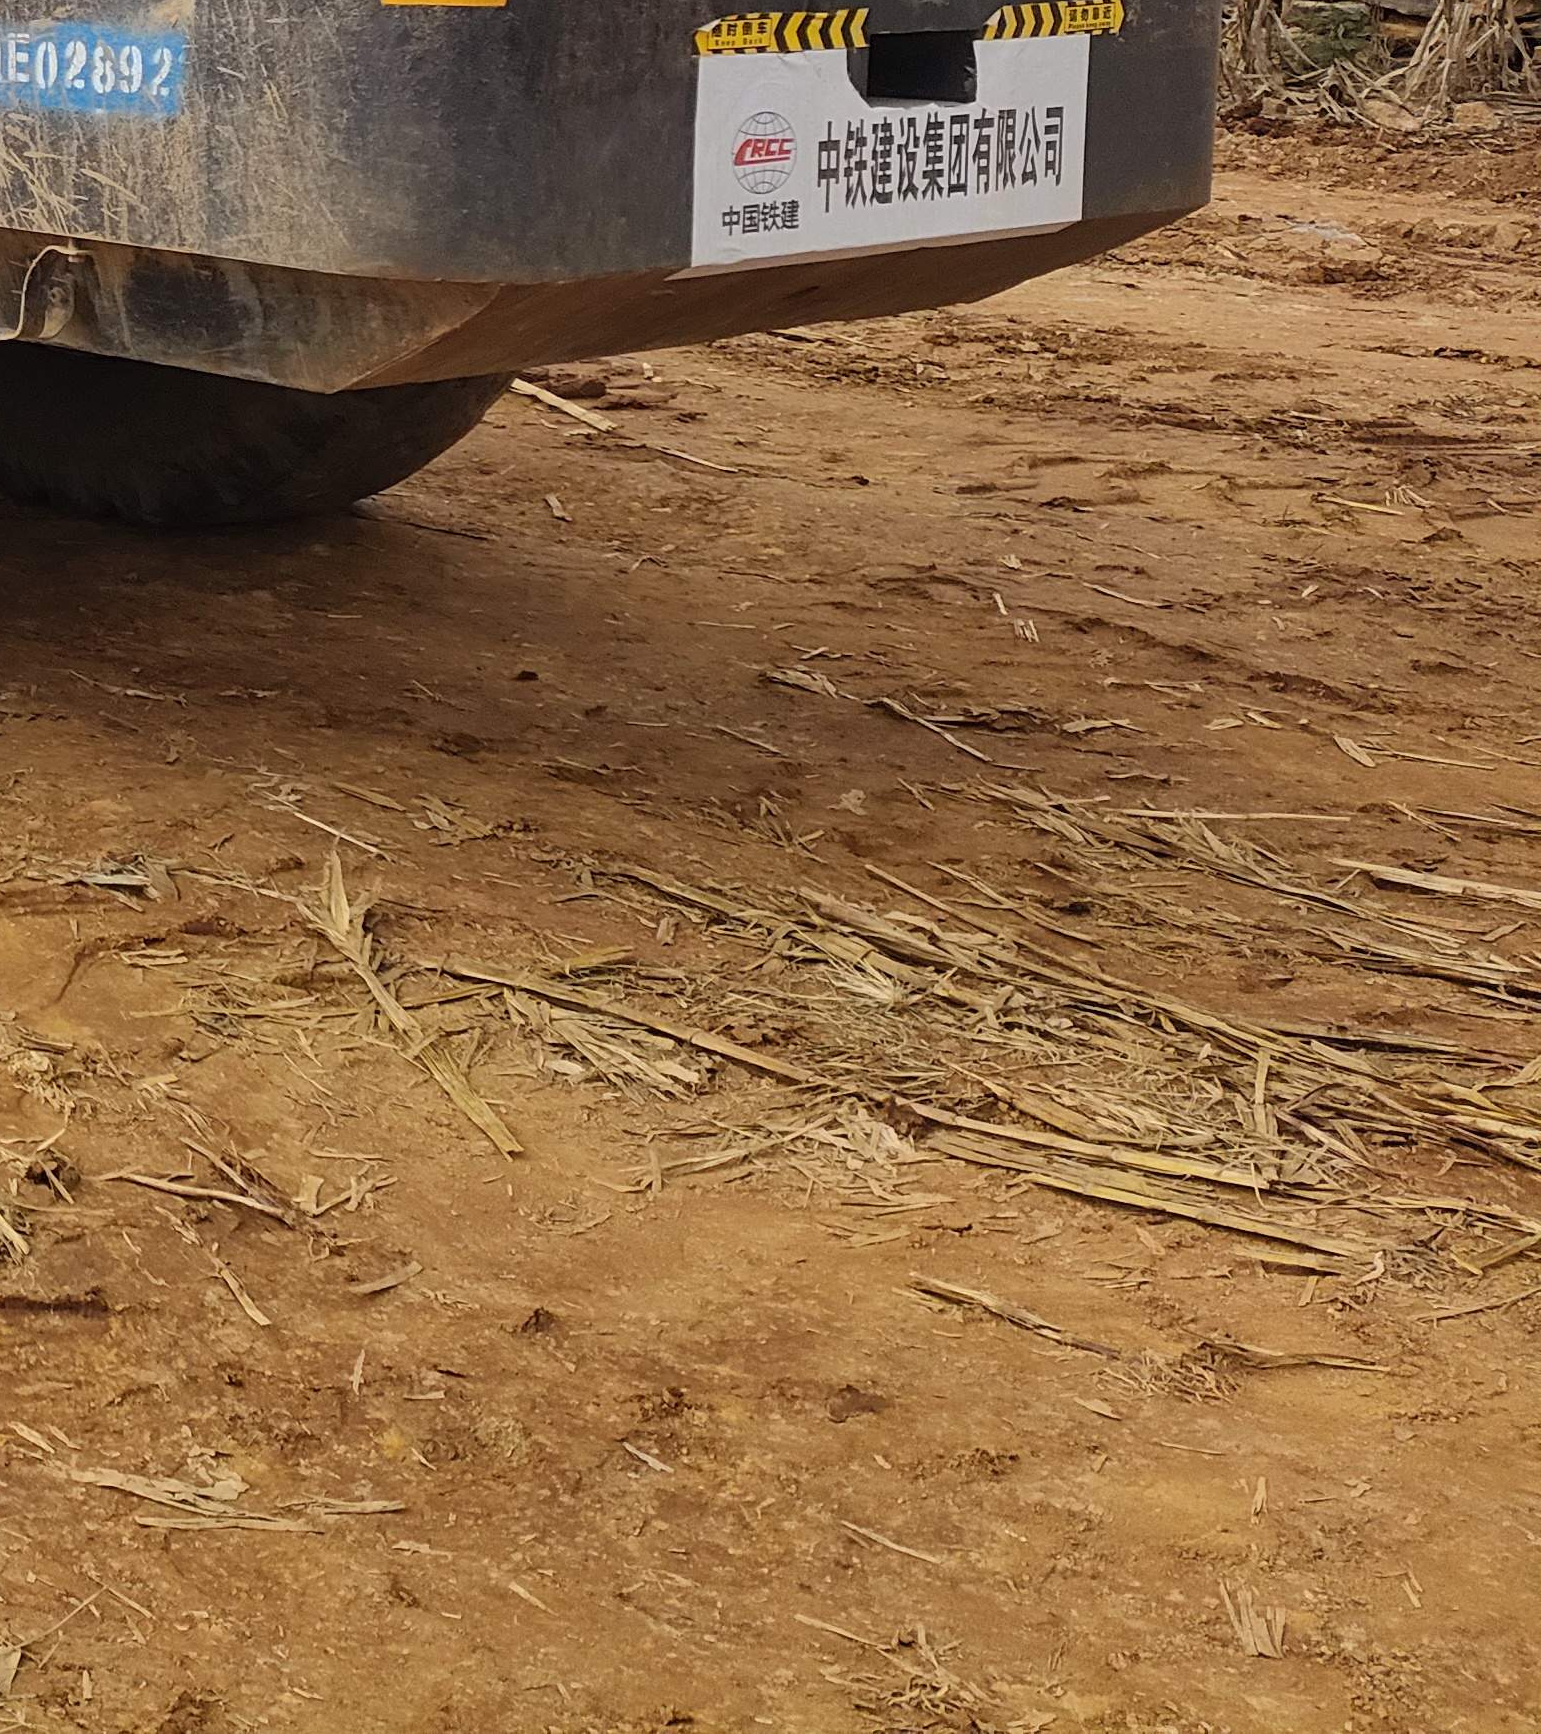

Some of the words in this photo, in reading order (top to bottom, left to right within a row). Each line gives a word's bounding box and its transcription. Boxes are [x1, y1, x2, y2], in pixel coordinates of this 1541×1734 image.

[816, 105, 1066, 214] 中铁建设集团有限公司
[721, 199, 801, 236] 中国铁建
